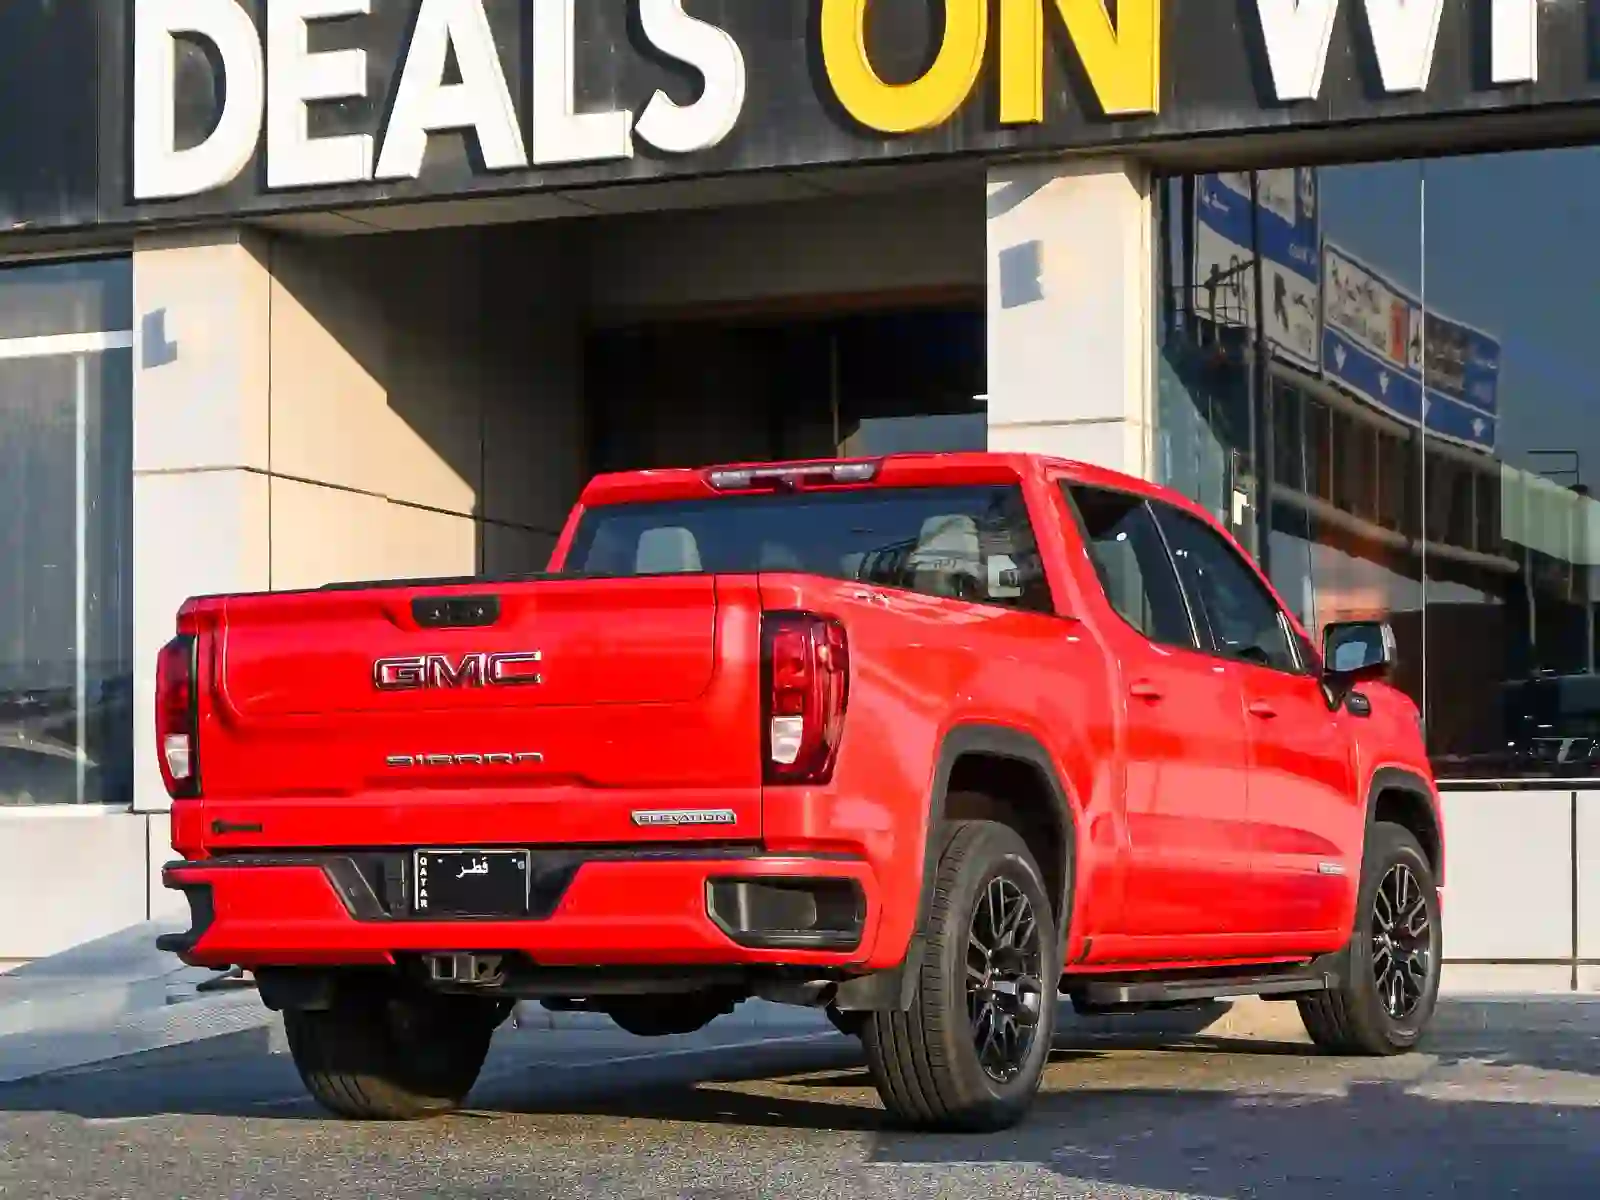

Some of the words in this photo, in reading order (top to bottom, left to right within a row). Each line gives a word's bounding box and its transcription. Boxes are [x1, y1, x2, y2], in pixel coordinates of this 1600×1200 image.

[132, 0, 746, 199] DEALS
[820, 0, 1161, 133] ON
[373, 650, 542, 691] GMC
[385, 751, 544, 768] SIERRA
[638, 812, 730, 824] ELEVATION
[419, 856, 429, 909] QATAR
[455, 855, 489, 880] قطر
